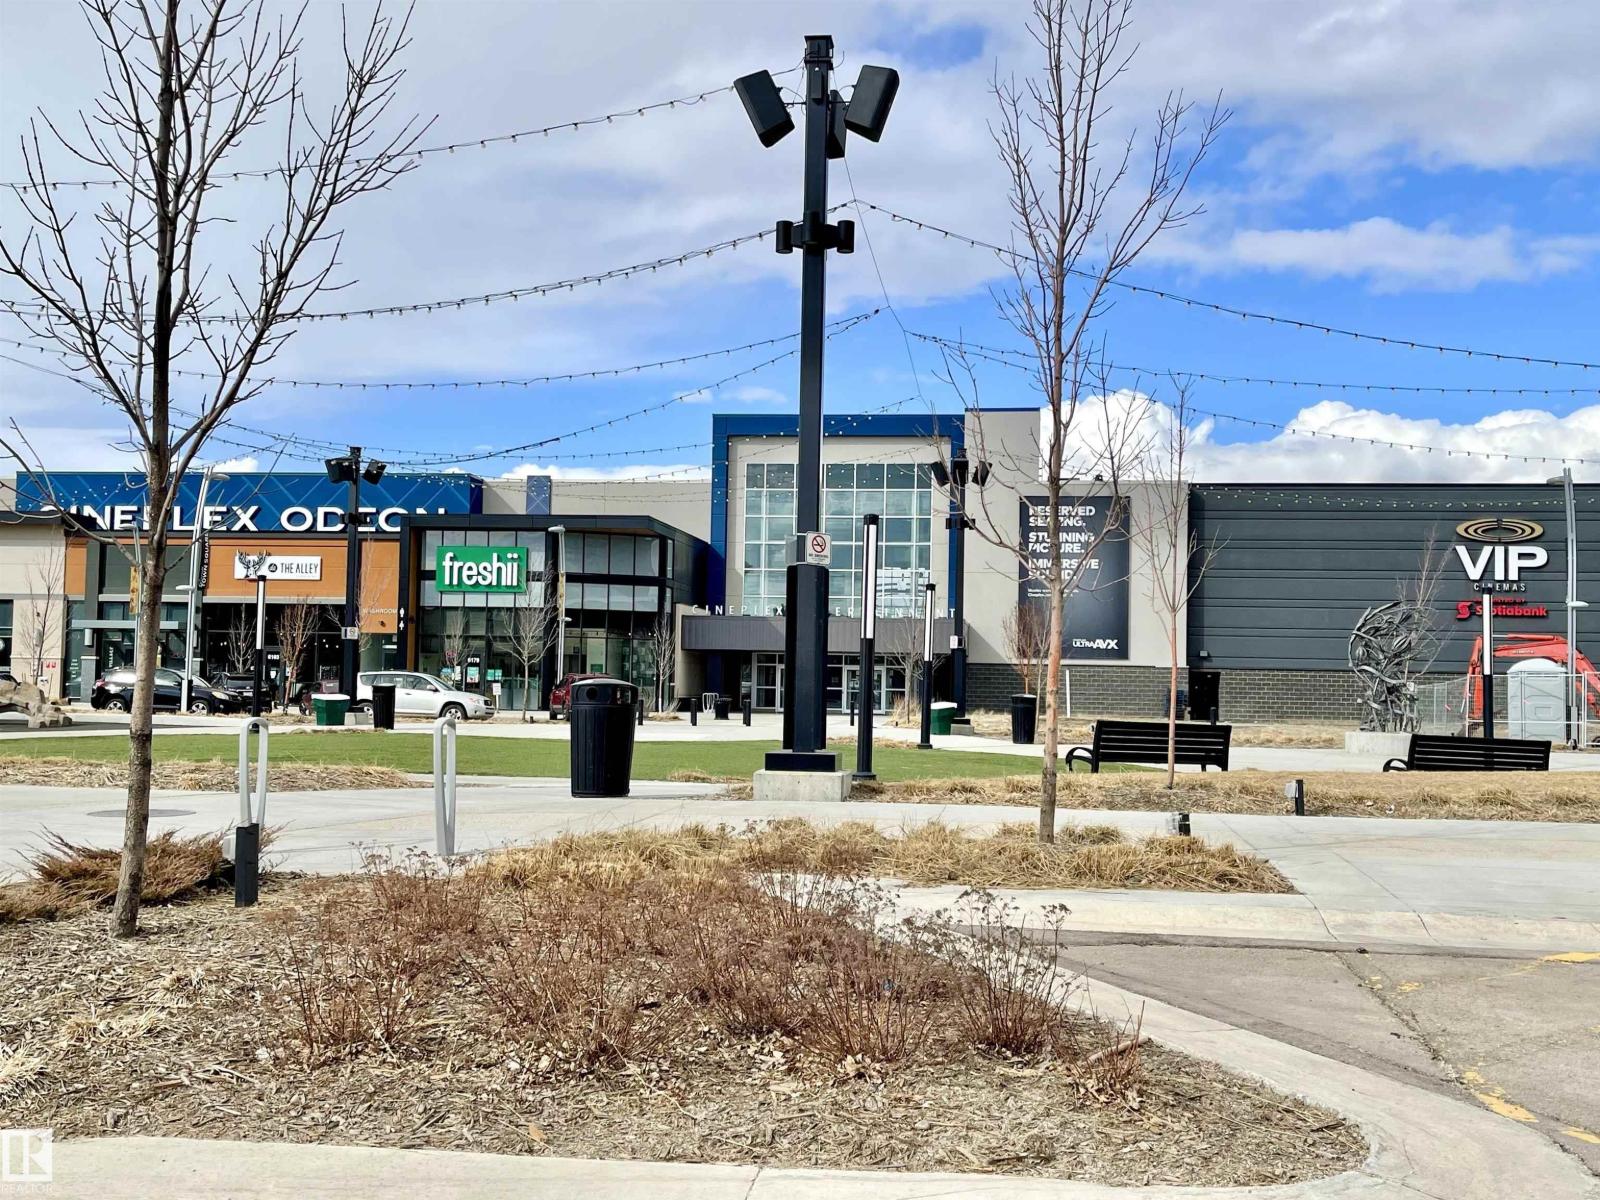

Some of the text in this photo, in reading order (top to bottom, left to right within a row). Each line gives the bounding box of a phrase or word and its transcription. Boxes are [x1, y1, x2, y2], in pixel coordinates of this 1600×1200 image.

[40, 505, 445, 532] NELEX ODEO
[1029, 532, 1095, 542] STUNING
[1029, 543, 1085, 553] PICURE.
[1455, 545, 1548, 580] VIP
[281, 563, 319, 574] THE ALLEY
[443, 552, 518, 586] freshii
[692, 605, 783, 616] CINEPLEX
[1475, 605, 1547, 616] Sotiabank
